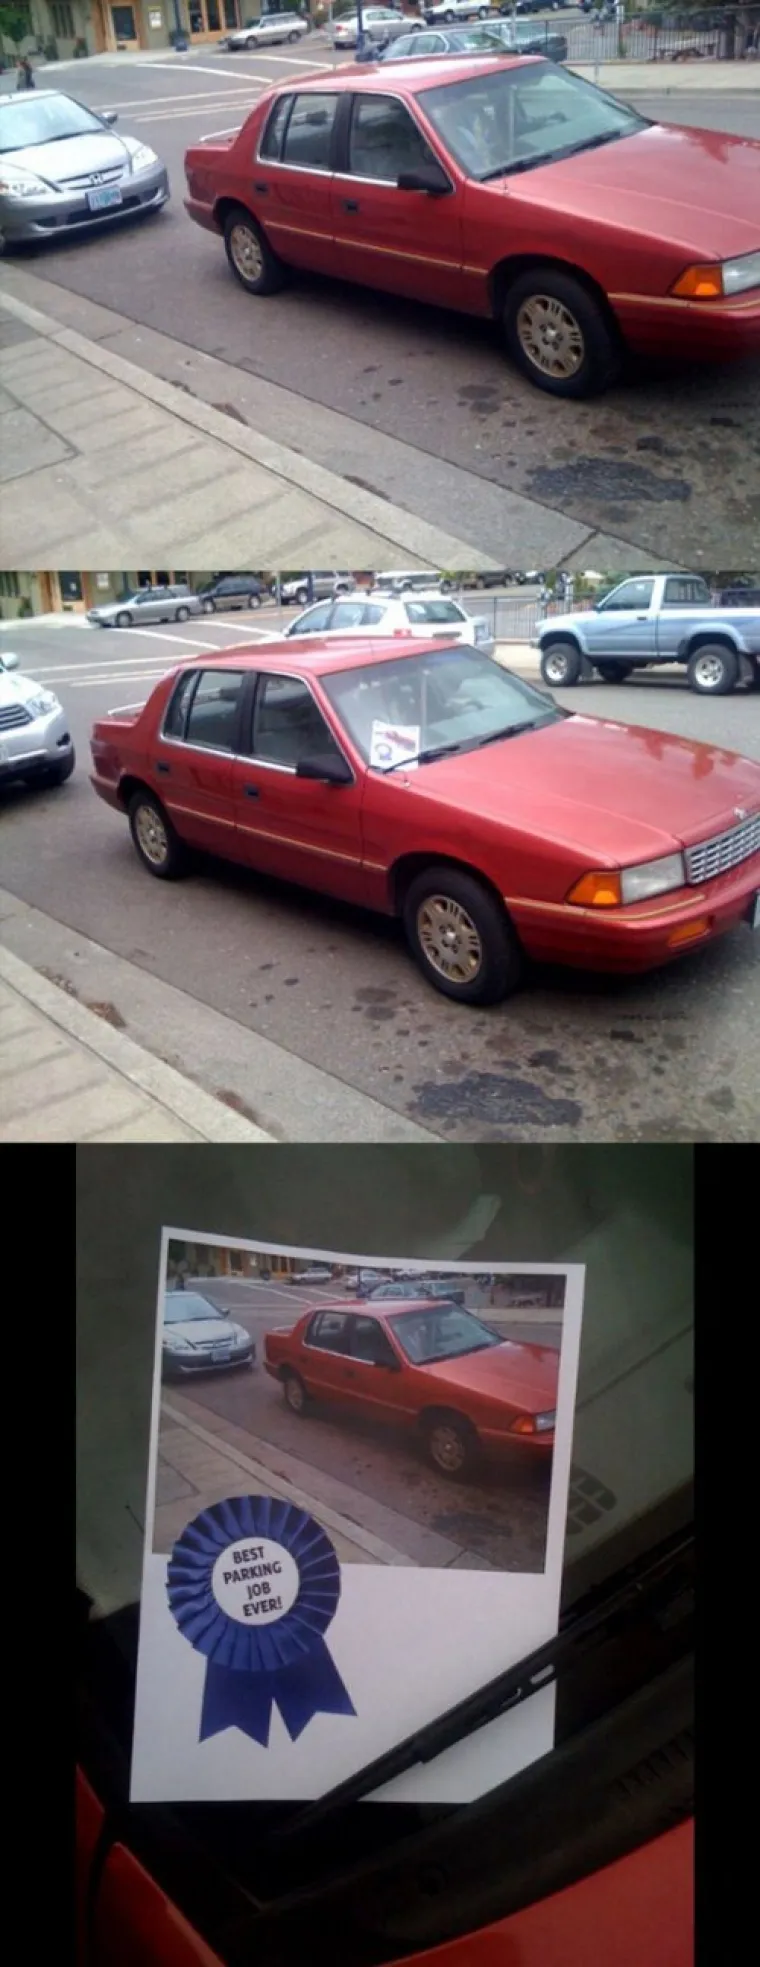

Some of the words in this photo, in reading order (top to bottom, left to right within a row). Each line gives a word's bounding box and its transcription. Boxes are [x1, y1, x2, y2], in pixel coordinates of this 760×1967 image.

[233, 1546, 264, 1564] BEST
[222, 1561, 282, 1584] PARKING
[247, 1581, 271, 1600] JOB
[243, 1596, 283, 1616] EVER!
